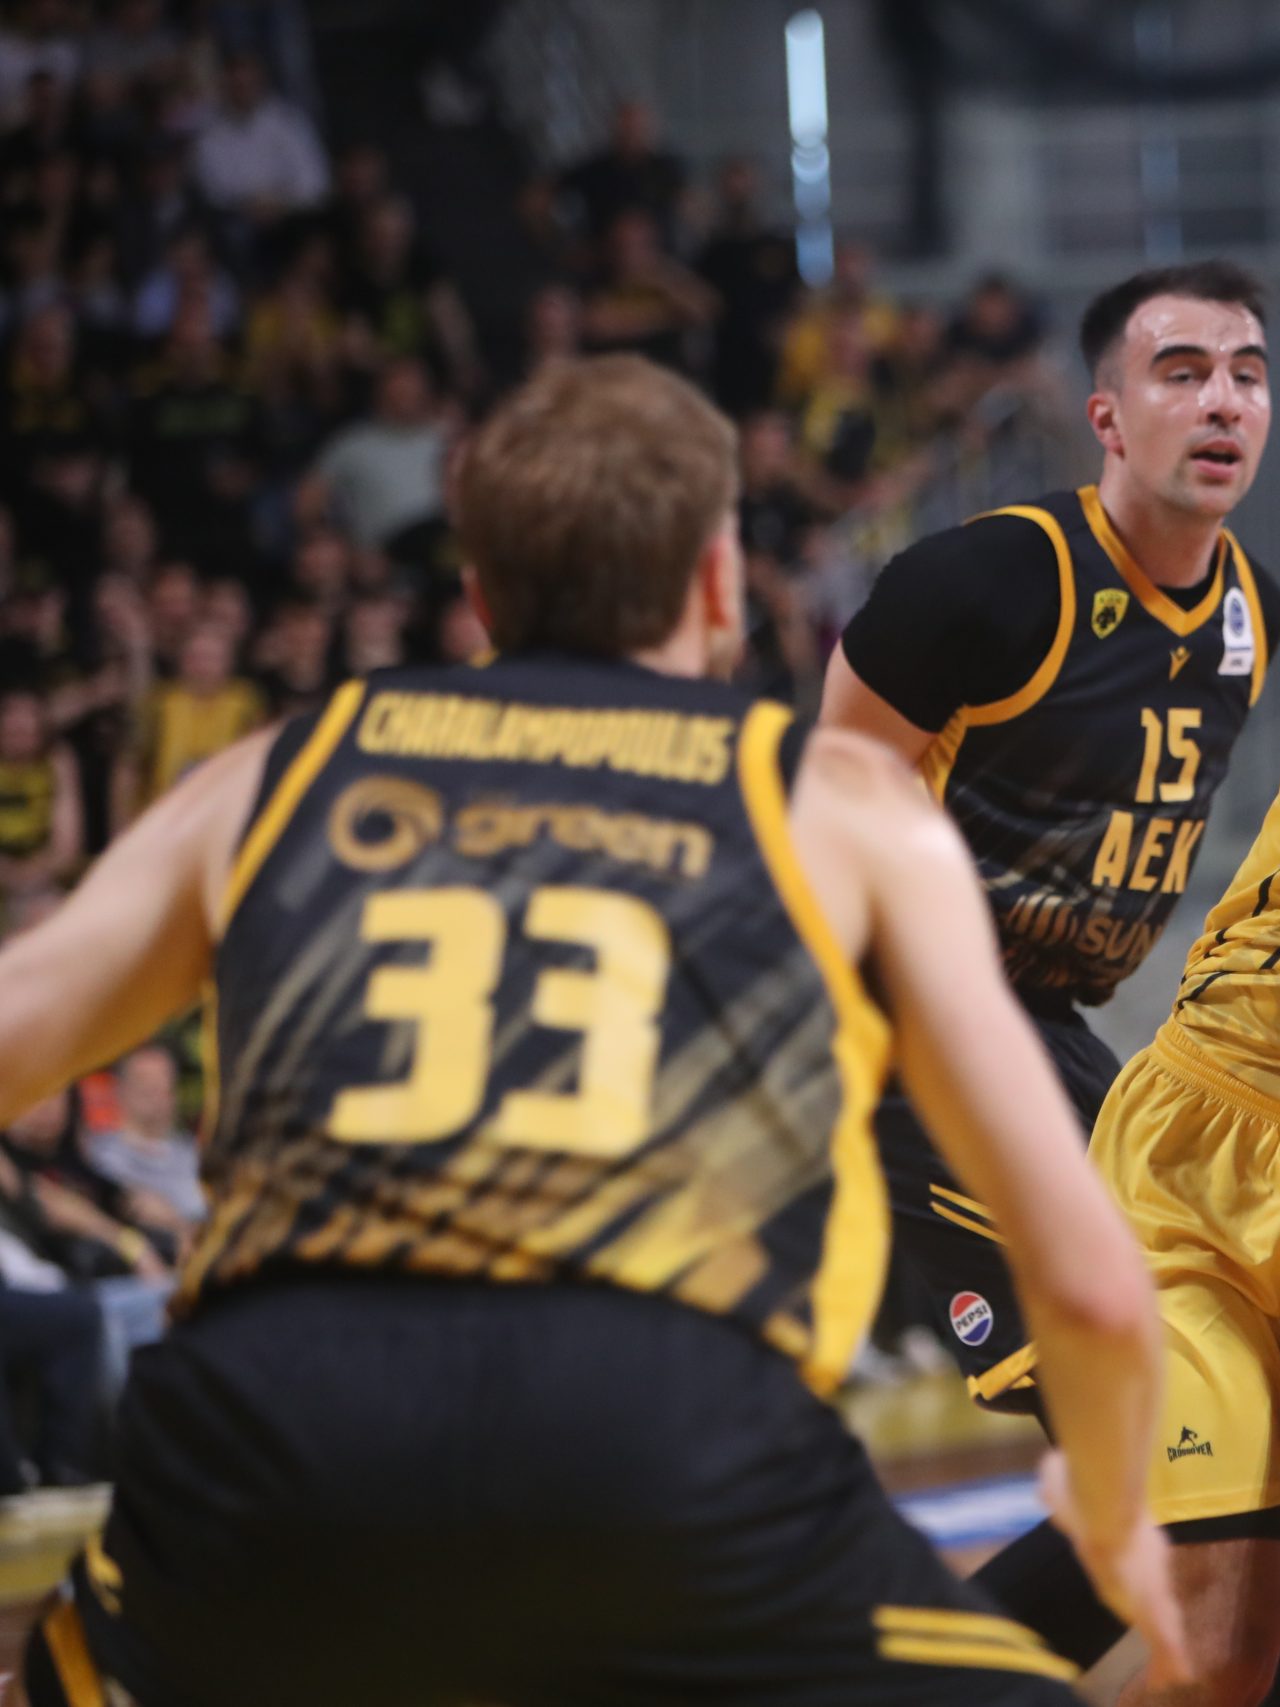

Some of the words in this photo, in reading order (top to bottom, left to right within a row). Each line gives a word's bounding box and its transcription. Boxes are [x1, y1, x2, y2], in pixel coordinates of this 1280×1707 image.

[1135, 708, 1201, 803] 15
[454, 803, 716, 880] green
[1092, 811, 1205, 894] AEK
[327, 885, 672, 1158] 33
[955, 1304, 989, 1332] PEPSI
